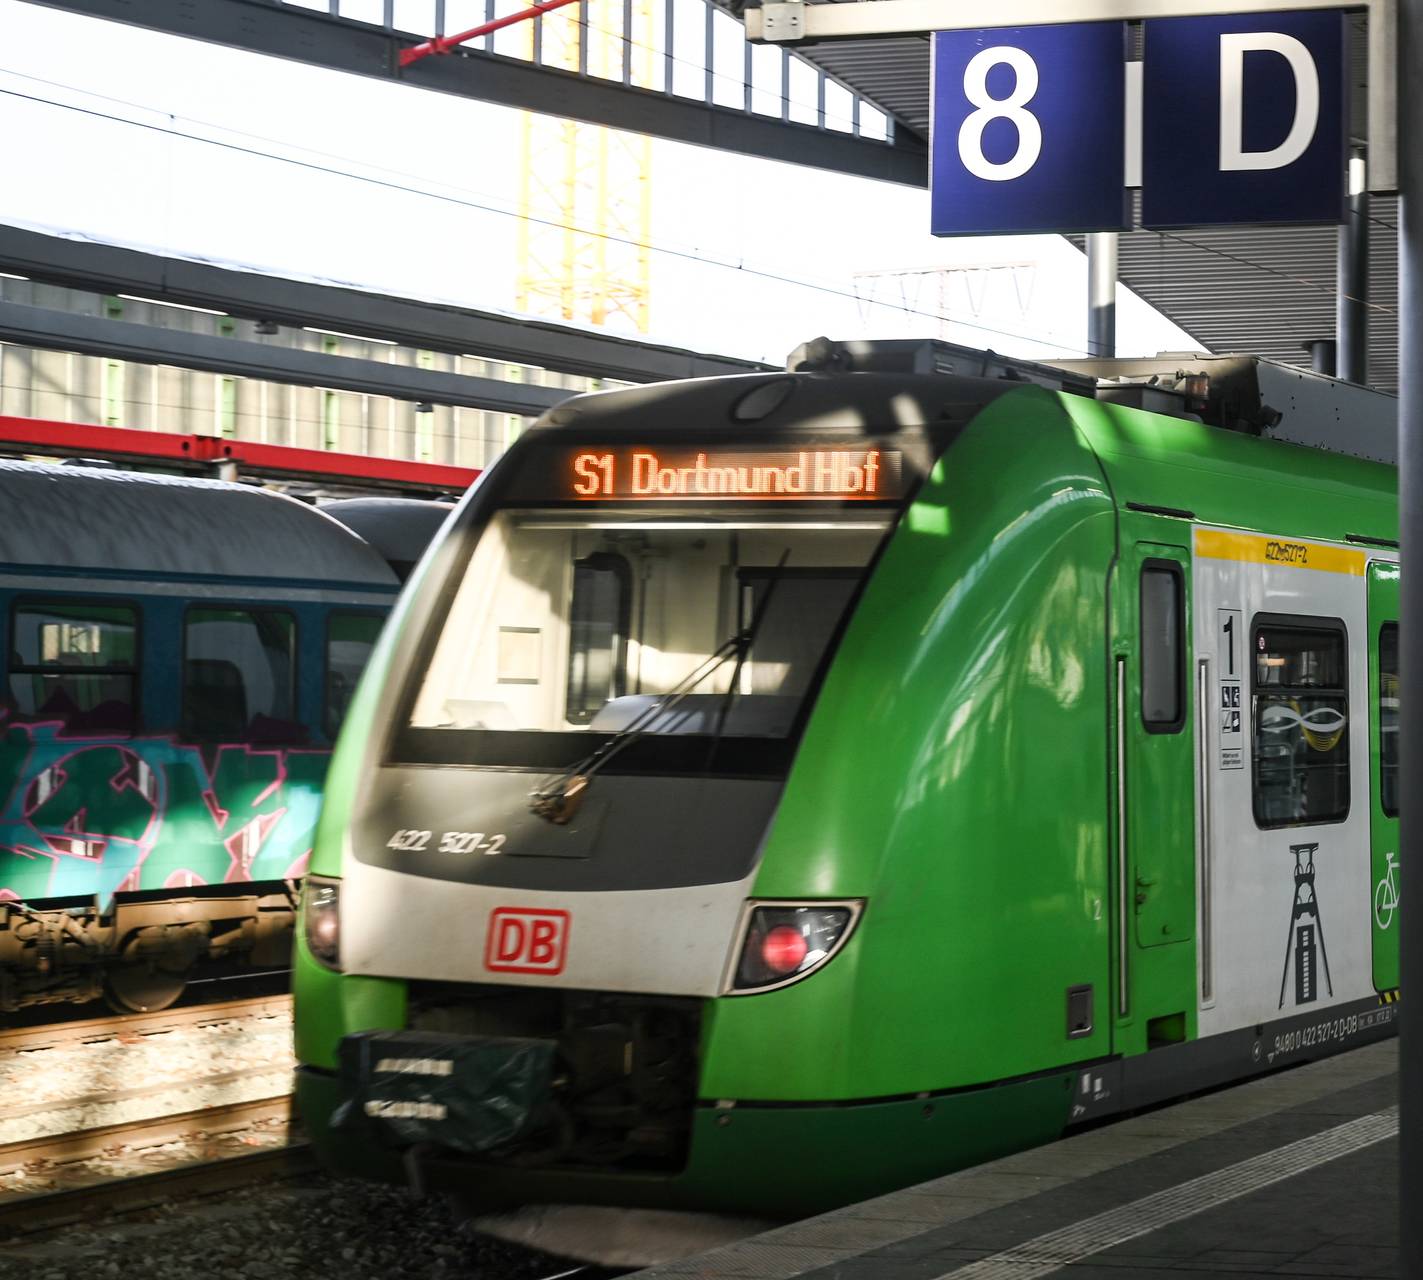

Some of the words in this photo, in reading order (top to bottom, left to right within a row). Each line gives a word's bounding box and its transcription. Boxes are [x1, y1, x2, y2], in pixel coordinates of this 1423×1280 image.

[957, 45, 1042, 181] 8
[1218, 31, 1321, 171] D
[573, 453, 614, 494] S1
[631, 452, 808, 494] Dortmund
[814, 450, 879, 493] Hbf
[1223, 615, 1234, 675] 1
[386, 829, 433, 851] 422
[438, 831, 507, 855] 527-2
[496, 918, 558, 964] DB
[1317, 1020, 1338, 1043] 527-2
